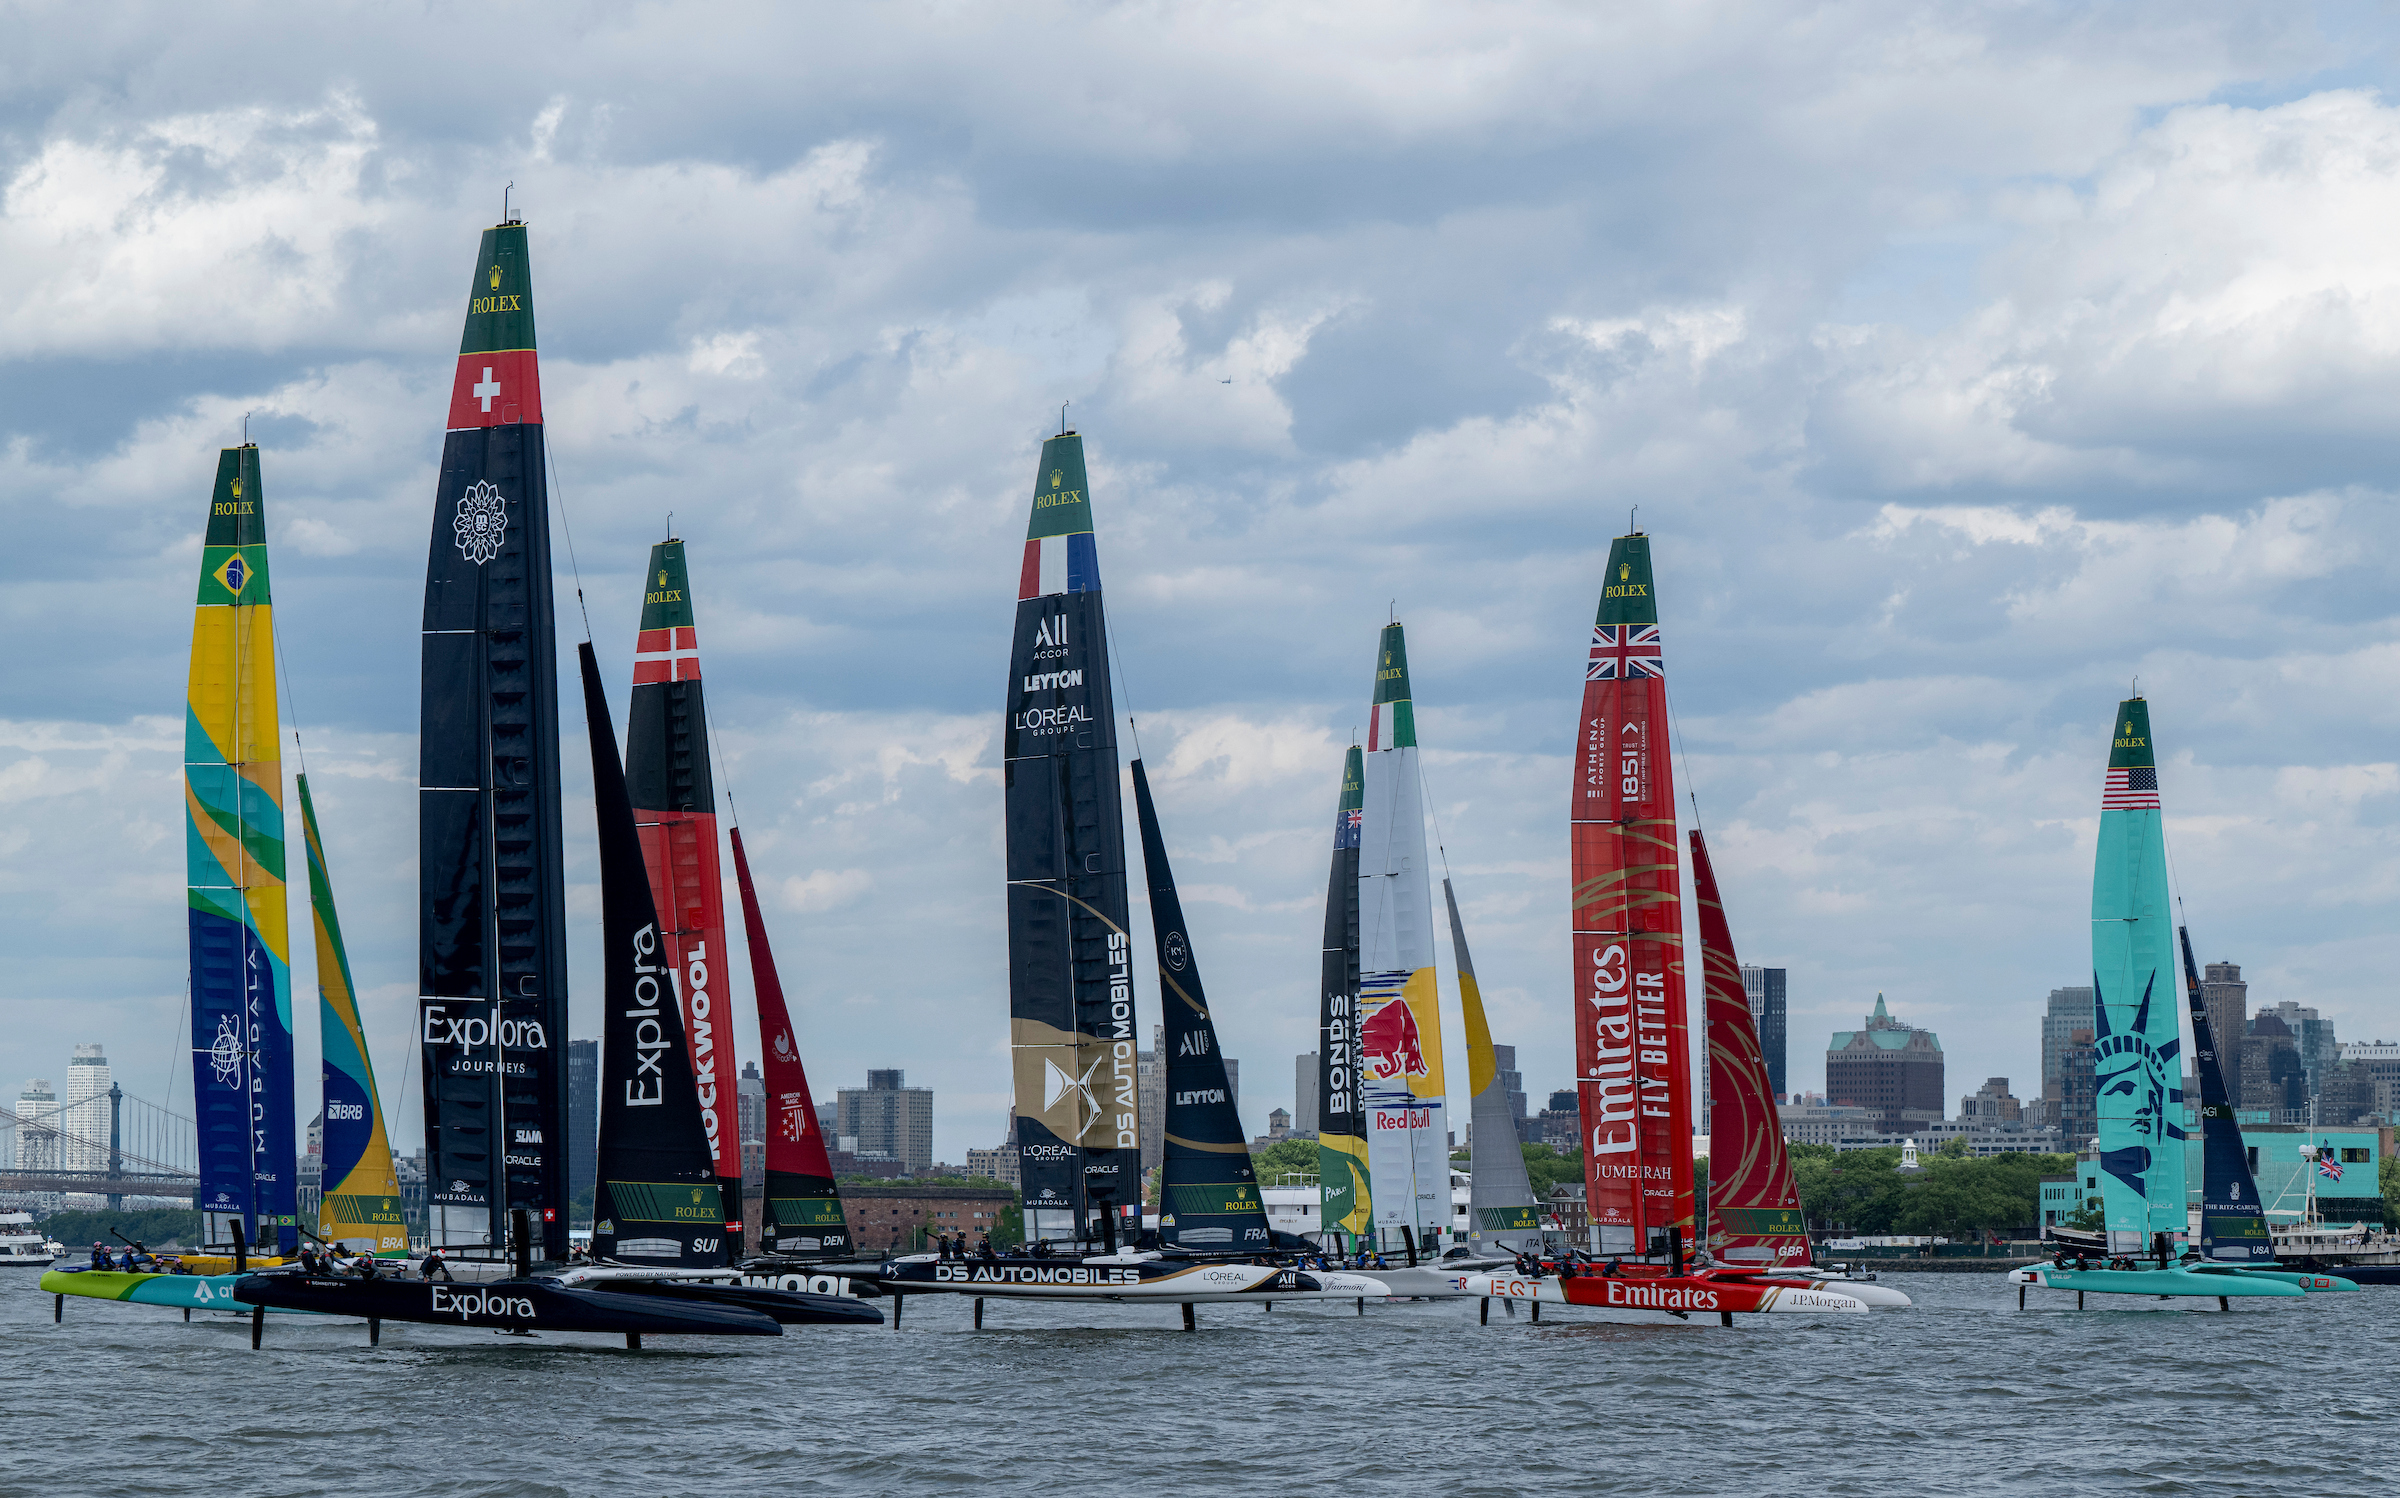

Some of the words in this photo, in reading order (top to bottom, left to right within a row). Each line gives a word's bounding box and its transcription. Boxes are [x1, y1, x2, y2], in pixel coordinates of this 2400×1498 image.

[471, 294, 521, 315] ROLEX
[1036, 489, 1082, 510] ROLEX
[214, 501, 254, 515] ROLEX
[646, 589, 682, 605] ROLEX
[1605, 584, 1647, 599] ROLEX
[1033, 648, 1069, 660] ACCOR
[1024, 669, 1083, 693] LEYTON
[1377, 667, 1402, 681] ROLEX
[1032, 725, 1075, 737] GROUPE
[2114, 737, 2146, 748] ROLEX
[1587, 717, 1599, 785] ATHENA
[1622, 750, 1639, 802] 1851
[625, 922, 672, 1107] Explora
[1107, 931, 1134, 1108] AUTOMOBILES
[1354, 992, 1363, 1050] UNDER
[1635, 971, 1668, 1065] BETTER
[423, 1005, 548, 1056] Explora
[247, 948, 266, 1153] MUBADALA
[688, 940, 721, 1161] ROCKWOOL
[1329, 994, 1346, 1114] BONDS
[1589, 944, 1637, 1158] Emirates
[451, 1060, 526, 1074] JOURNEYS
[1356, 1054, 1365, 1112] DOWN
[780, 1092, 801, 1100] AMERICAN
[1175, 1088, 1225, 1106] LEYTON
[1641, 1075, 1671, 1118] FLY
[340, 1104, 363, 1120] BRB
[1376, 1109, 1408, 1130] Red
[1410, 1108, 1430, 1129] Bull
[515, 1129, 543, 1144] SLAM
[1116, 1111, 1136, 1148] DS
[505, 1155, 542, 1167] ORACLE
[254, 1172, 277, 1182] ORACLE
[1084, 1165, 1119, 1174] ORACLE
[1593, 1162, 1672, 1182] JUMEIRAH
[434, 1193, 485, 1203] MUBADALA
[1644, 1189, 1674, 1197] ORACLE
[674, 1206, 716, 1218] ROLEX
[1225, 1201, 1258, 1211] ROLEX
[372, 1212, 401, 1222] ROLEX
[815, 1214, 841, 1222] ROLEX
[1513, 1219, 1537, 1228] ROLEX
[1244, 1228, 1269, 1240] FRA
[1768, 1224, 1801, 1233] ROLEX
[381, 1236, 404, 1249] BRA
[692, 1237, 719, 1253] SUI
[823, 1235, 845, 1246] DEN
[1525, 1239, 1540, 1248] ITA
[1778, 1246, 1804, 1257] GBR
[2252, 1245, 2270, 1255] USA
[935, 1265, 968, 1282] DS
[972, 1266, 1140, 1285] AUTOMOBILES
[1320, 1275, 1368, 1293] Fairmont
[431, 1285, 536, 1321] Explora
[1606, 1281, 1719, 1310] Emirates
